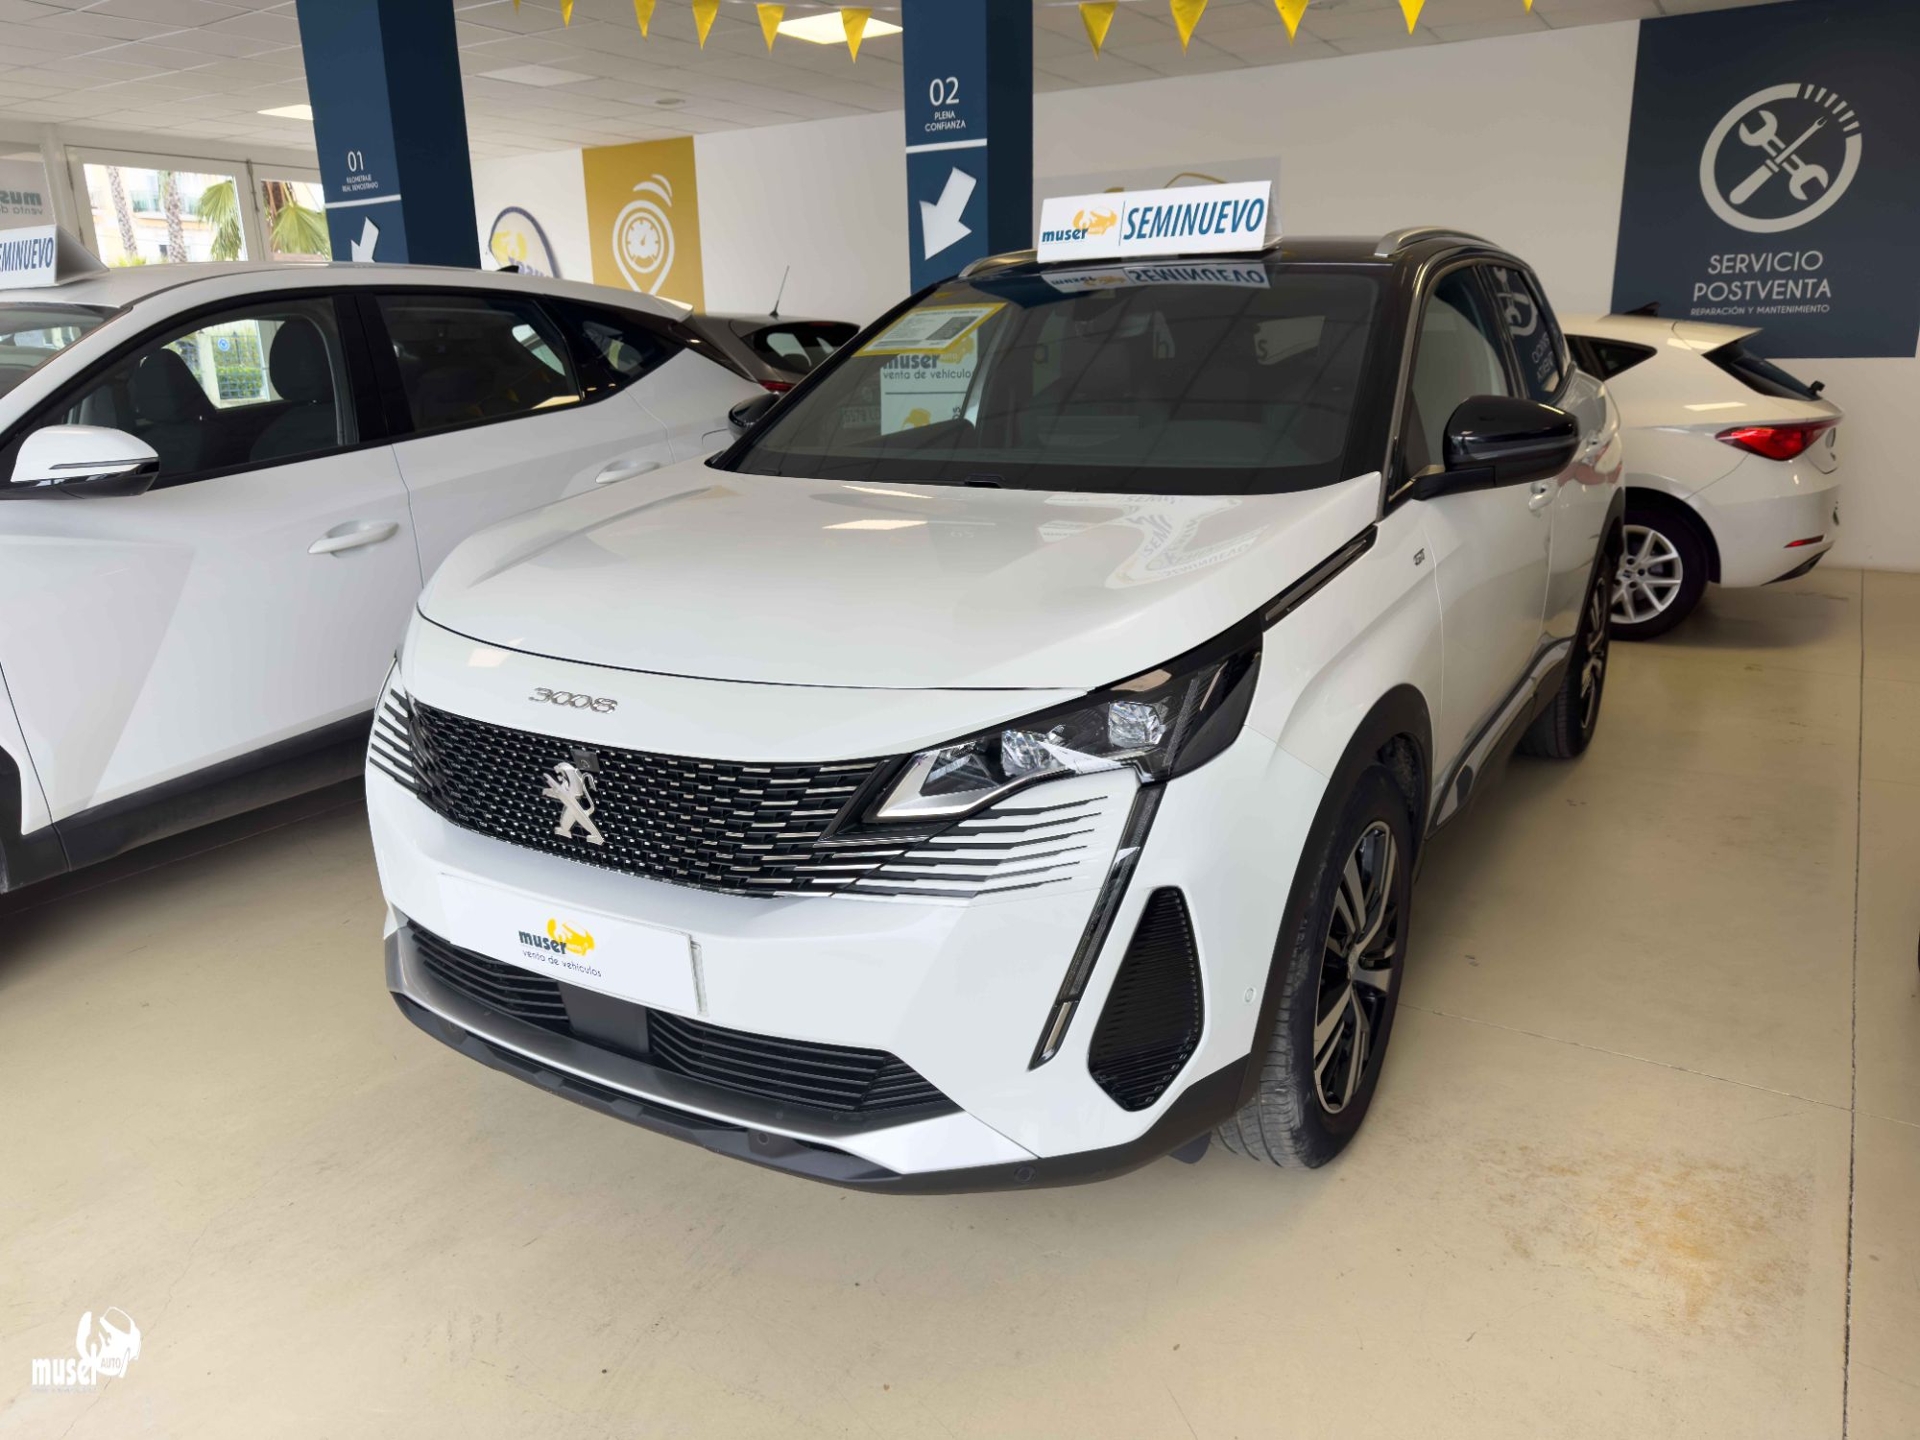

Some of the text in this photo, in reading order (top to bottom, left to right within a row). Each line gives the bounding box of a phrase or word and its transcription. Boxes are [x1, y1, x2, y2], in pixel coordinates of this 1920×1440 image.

[929, 76, 960, 107] 02
[924, 119, 967, 132] CONFIANZA
[934, 110, 956, 120] PLENA
[347, 150, 364, 172] 01
[1123, 198, 1265, 240] SEMINUEVO
[1042, 227, 1089, 243] muser
[1707, 250, 1824, 275] SERVICIO
[1693, 278, 1831, 302] POSTVENTA
[1747, 306, 1755, 315] Y
[1756, 304, 1831, 315] MANTENIMIENTO
[914, 369, 926, 379] de
[528, 687, 618, 713] 3008
[518, 931, 567, 954] muser
[522, 950, 546, 962] venta
[547, 955, 560, 966] de
